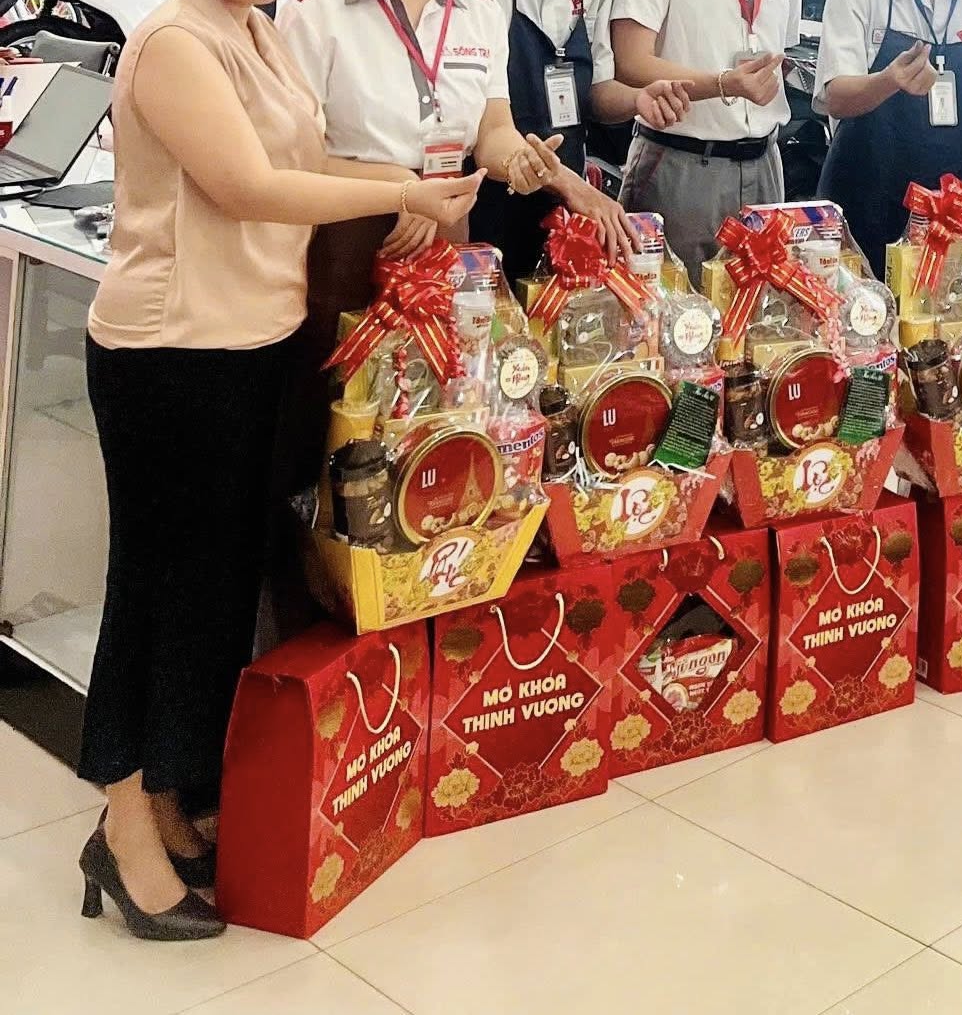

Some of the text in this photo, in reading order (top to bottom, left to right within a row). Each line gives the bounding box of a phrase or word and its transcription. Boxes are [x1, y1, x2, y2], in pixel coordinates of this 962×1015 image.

[453, 46, 477, 56] SÔNG
[788, 383, 801, 400] LU
[603, 408, 617, 427] LU
[496, 429, 545, 455] mentos
[421, 468, 436, 488] LU
